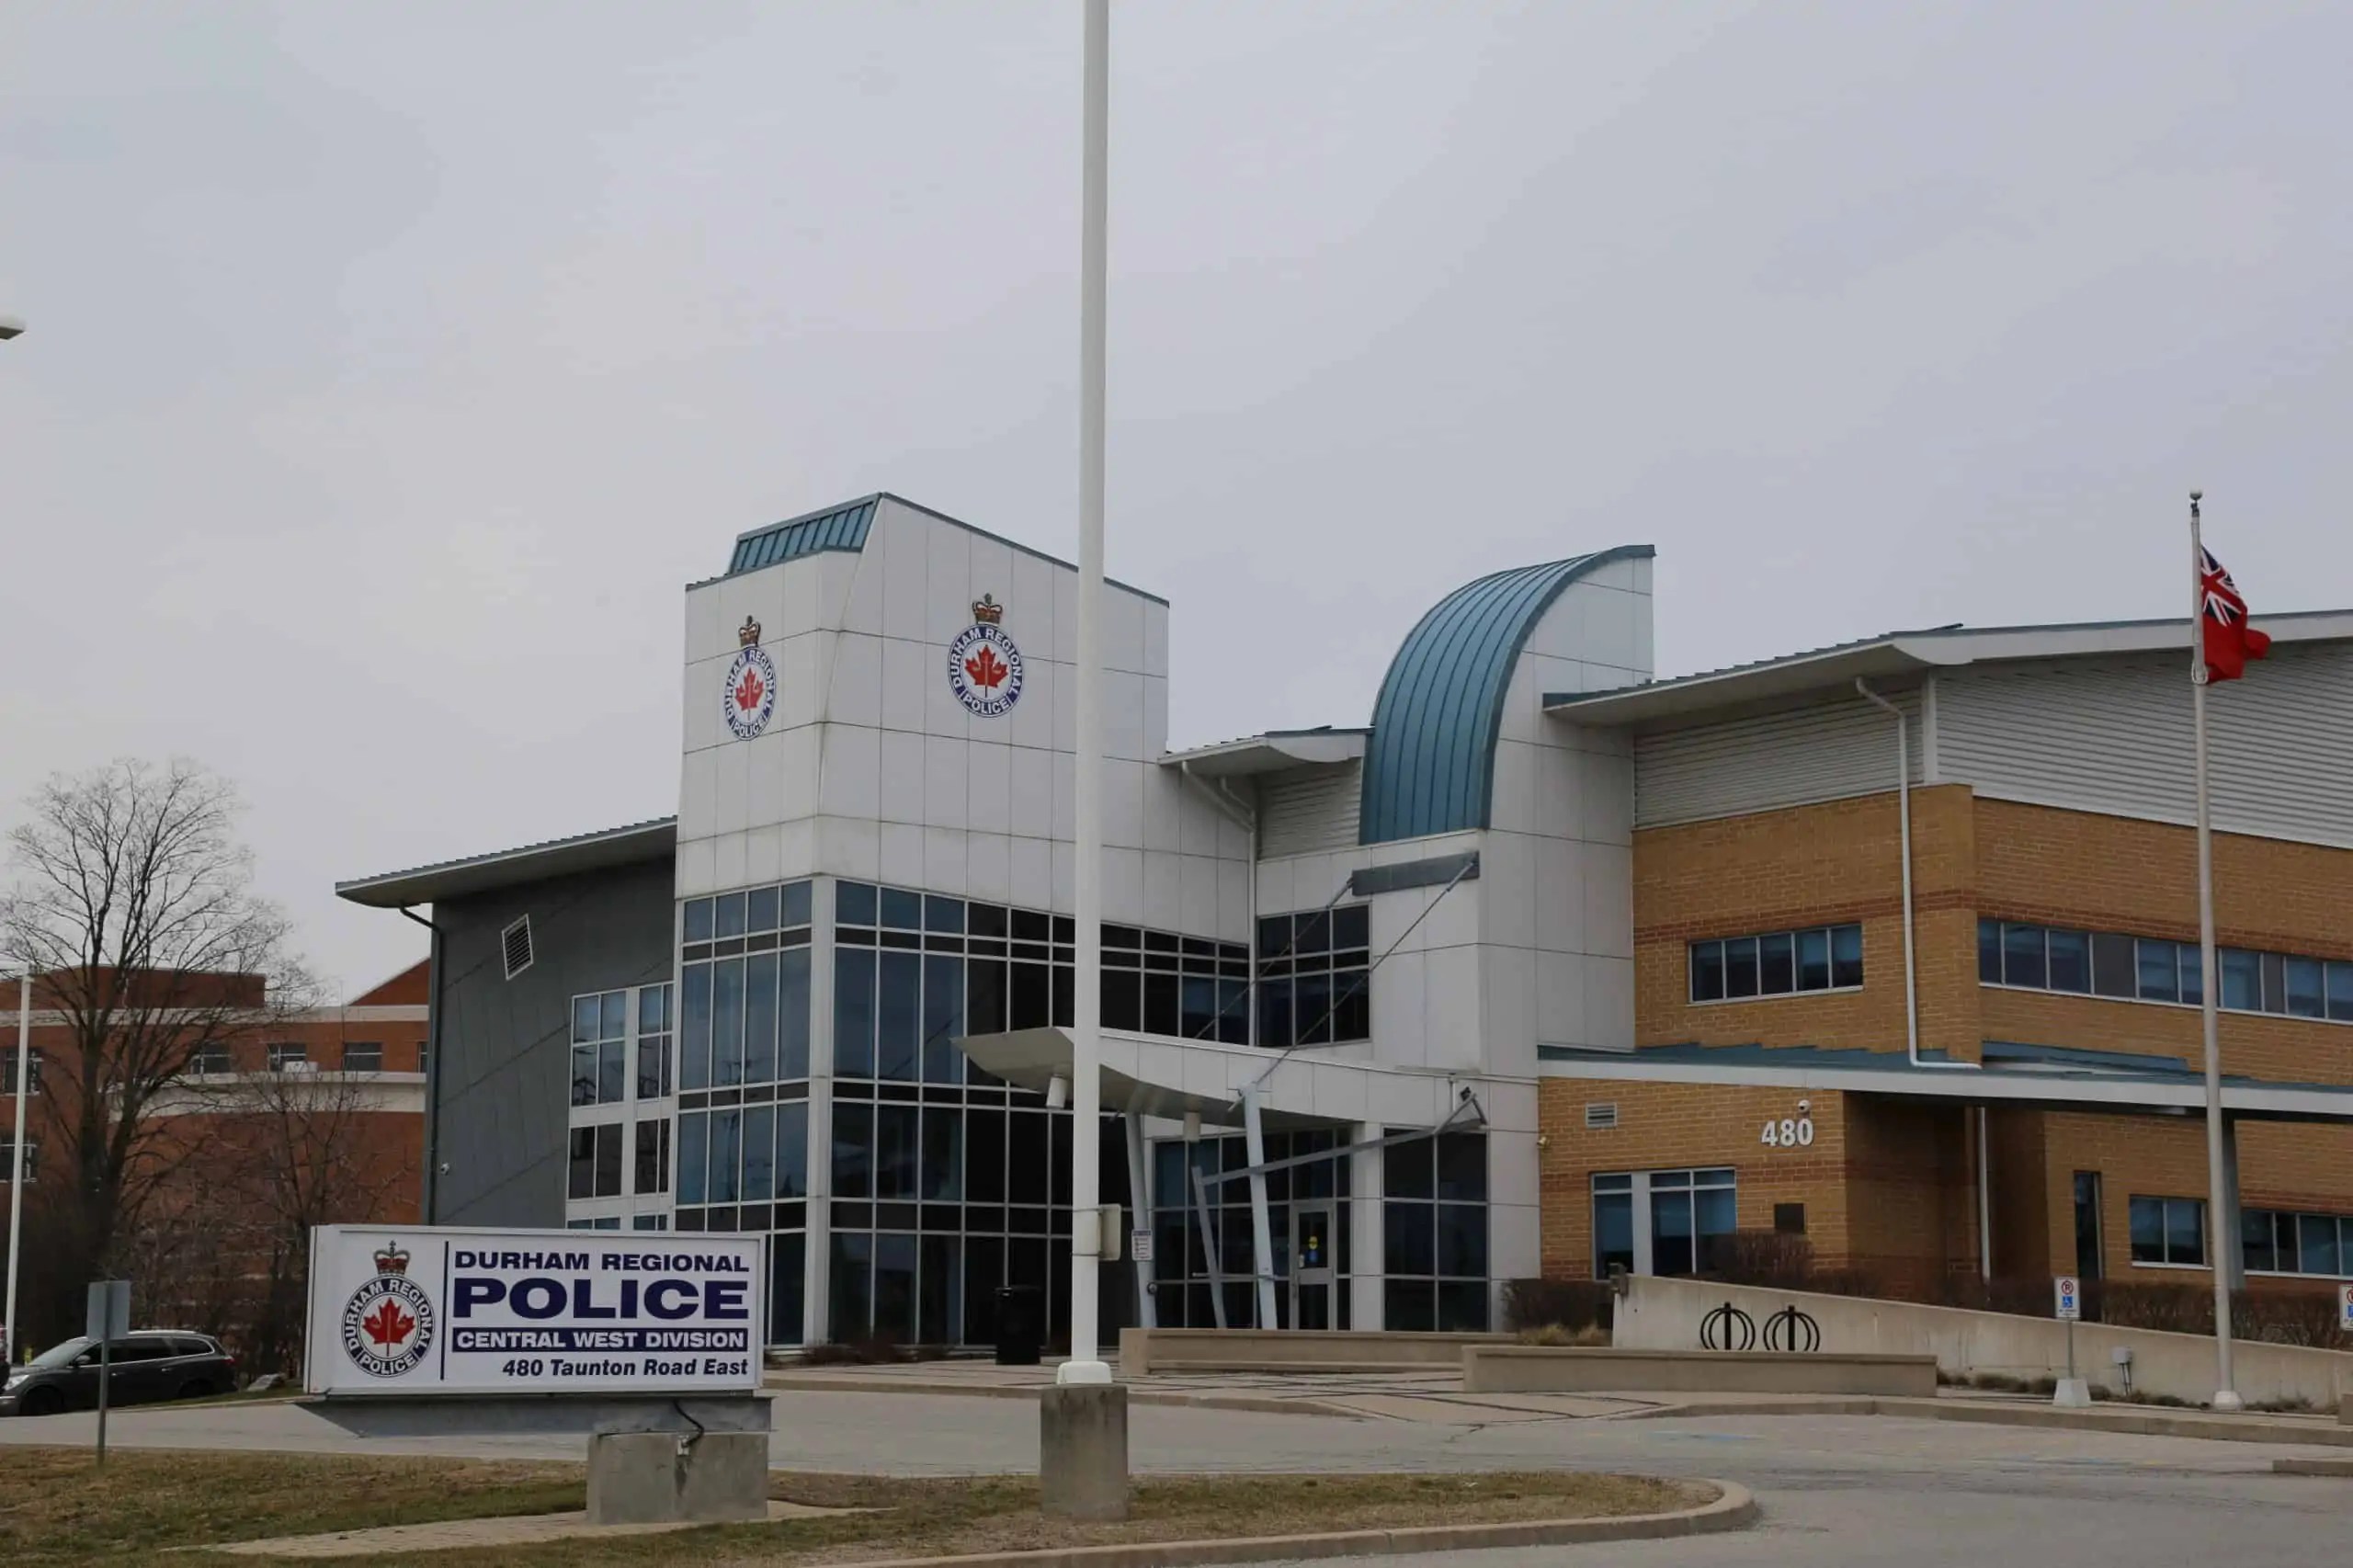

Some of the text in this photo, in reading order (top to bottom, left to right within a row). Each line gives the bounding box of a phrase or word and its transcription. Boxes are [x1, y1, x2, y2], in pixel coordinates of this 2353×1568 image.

[950, 628, 1022, 695] DURHAM REGIONAL
[749, 649, 774, 709] REGIONAL
[962, 695, 1009, 714] POLICE
[733, 715, 766, 737] POLICE
[1761, 1119, 1813, 1146] 480
[455, 1251, 749, 1272] DURHAM REGIONAL
[453, 1278, 749, 1320] POLICE
[345, 1278, 432, 1351] DURHAM REGIONAL
[457, 1332, 745, 1348] CENTRAL WEST DIVISION
[358, 1351, 416, 1375] POLICE
[503, 1358, 748, 1377] 480 Taunton Road East
